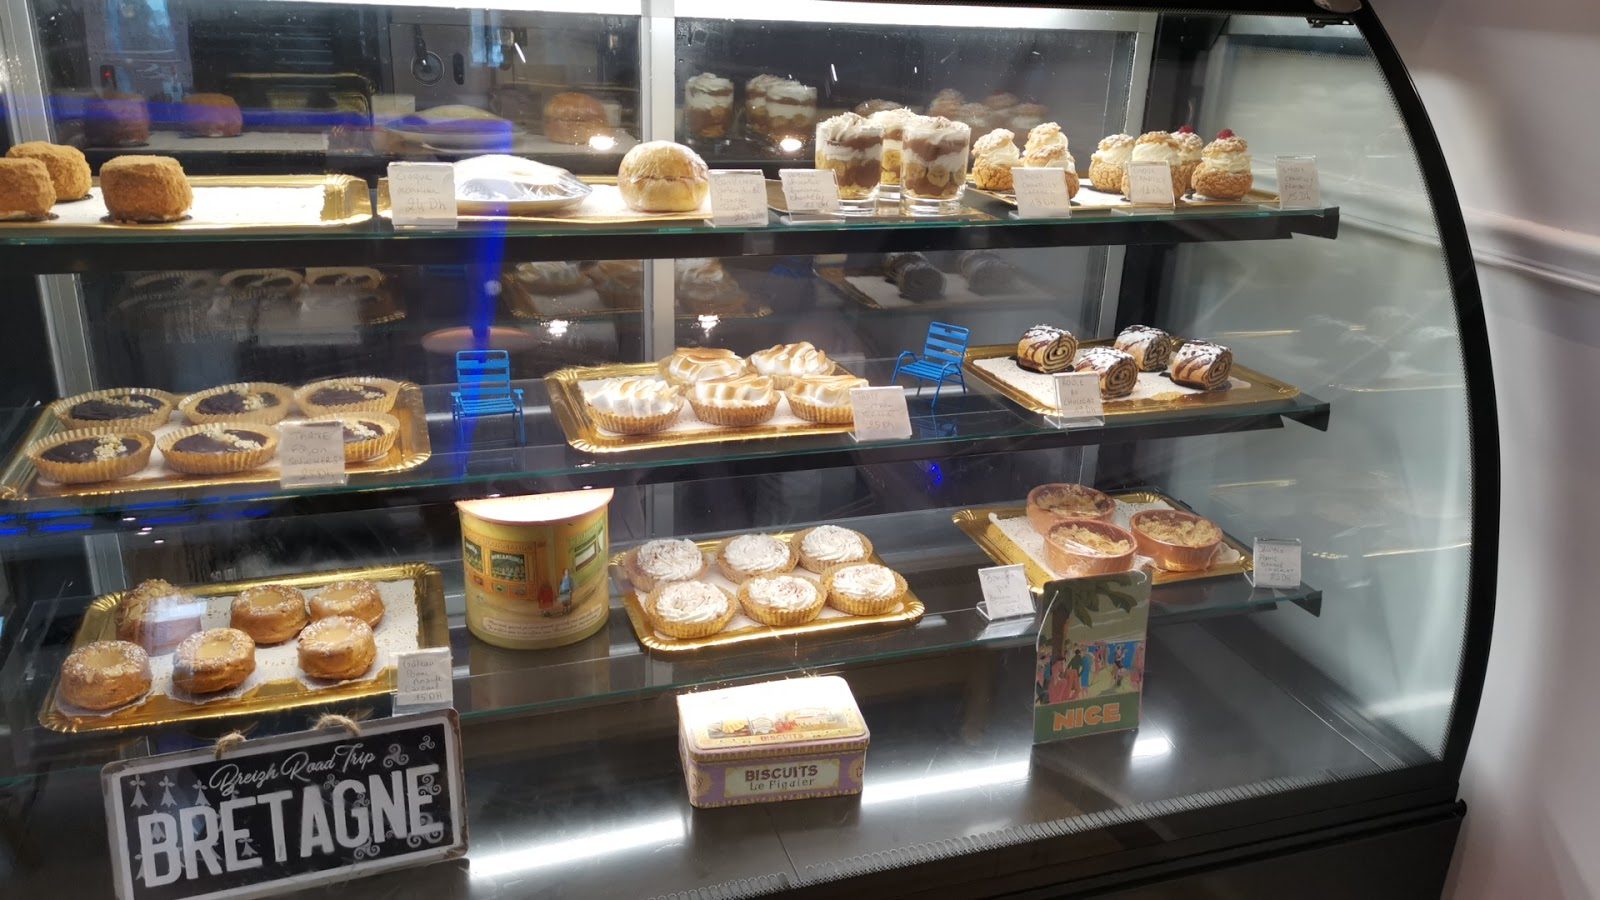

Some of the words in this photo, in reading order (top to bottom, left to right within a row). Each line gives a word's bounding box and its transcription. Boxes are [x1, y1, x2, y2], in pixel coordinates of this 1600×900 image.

[1053, 702, 1121, 731] NICE
[209, 763, 279, 796] Breizh
[280, 751, 337, 782] Road
[334, 743, 376, 774] Trip
[745, 764, 818, 782] BISCUITS
[750, 781, 765, 791] Le
[138, 764, 444, 888] BRETAGNE
